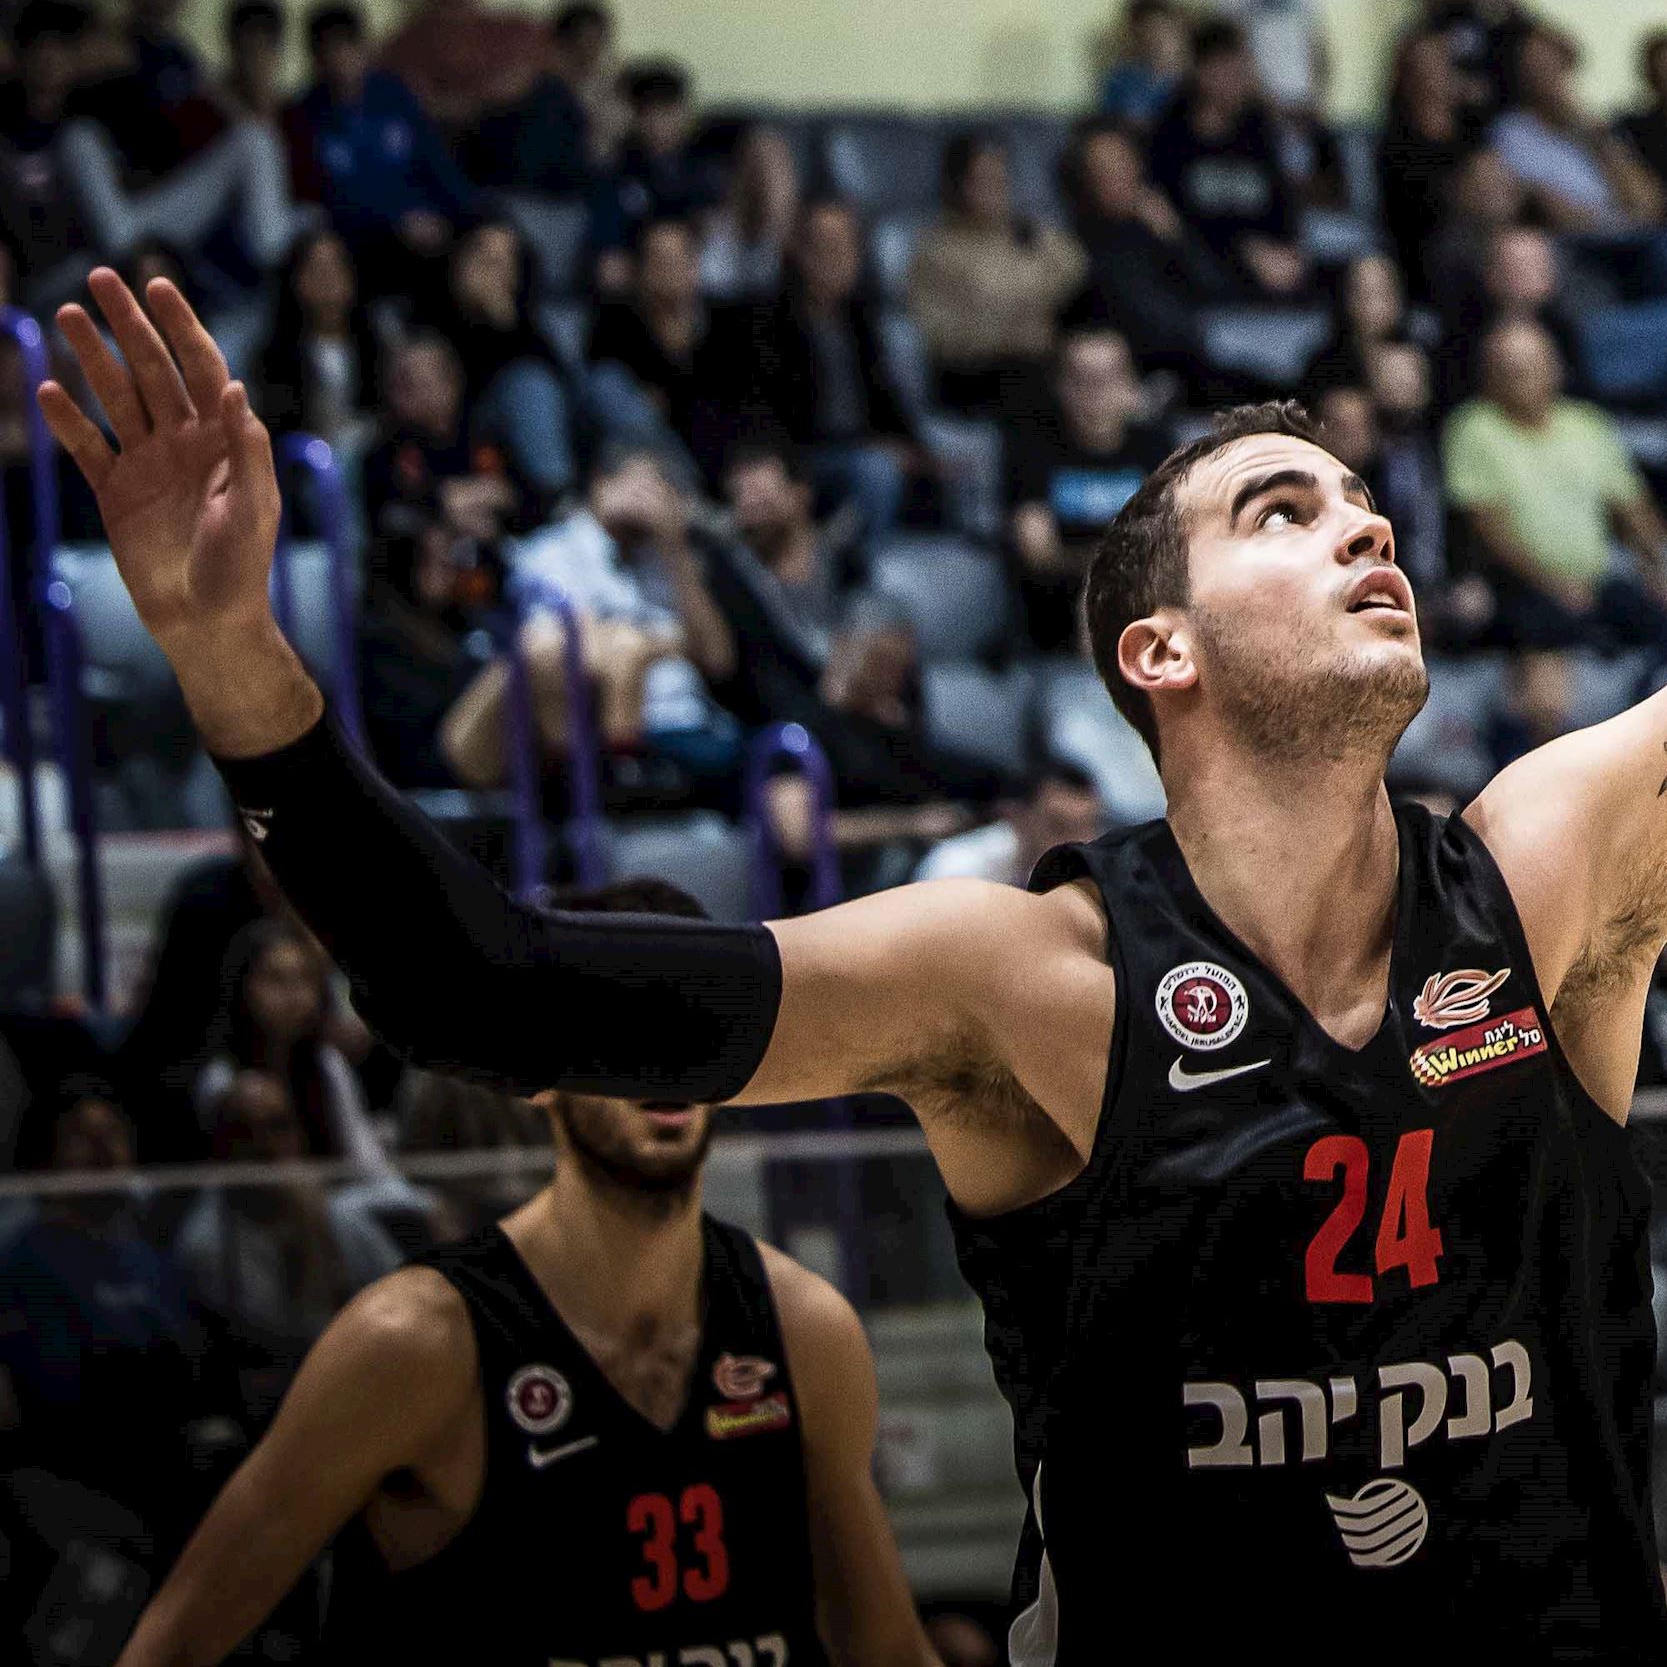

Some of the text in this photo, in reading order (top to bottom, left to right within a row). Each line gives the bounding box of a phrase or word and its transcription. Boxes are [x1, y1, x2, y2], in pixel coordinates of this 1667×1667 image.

[1428, 1036, 1518, 1075] Winner
[1518, 1028, 1541, 1047] סל
[1303, 1129, 1444, 1304] 24
[1183, 1340, 1533, 1469] בנק יהב
[627, 1482, 730, 1612] 33
